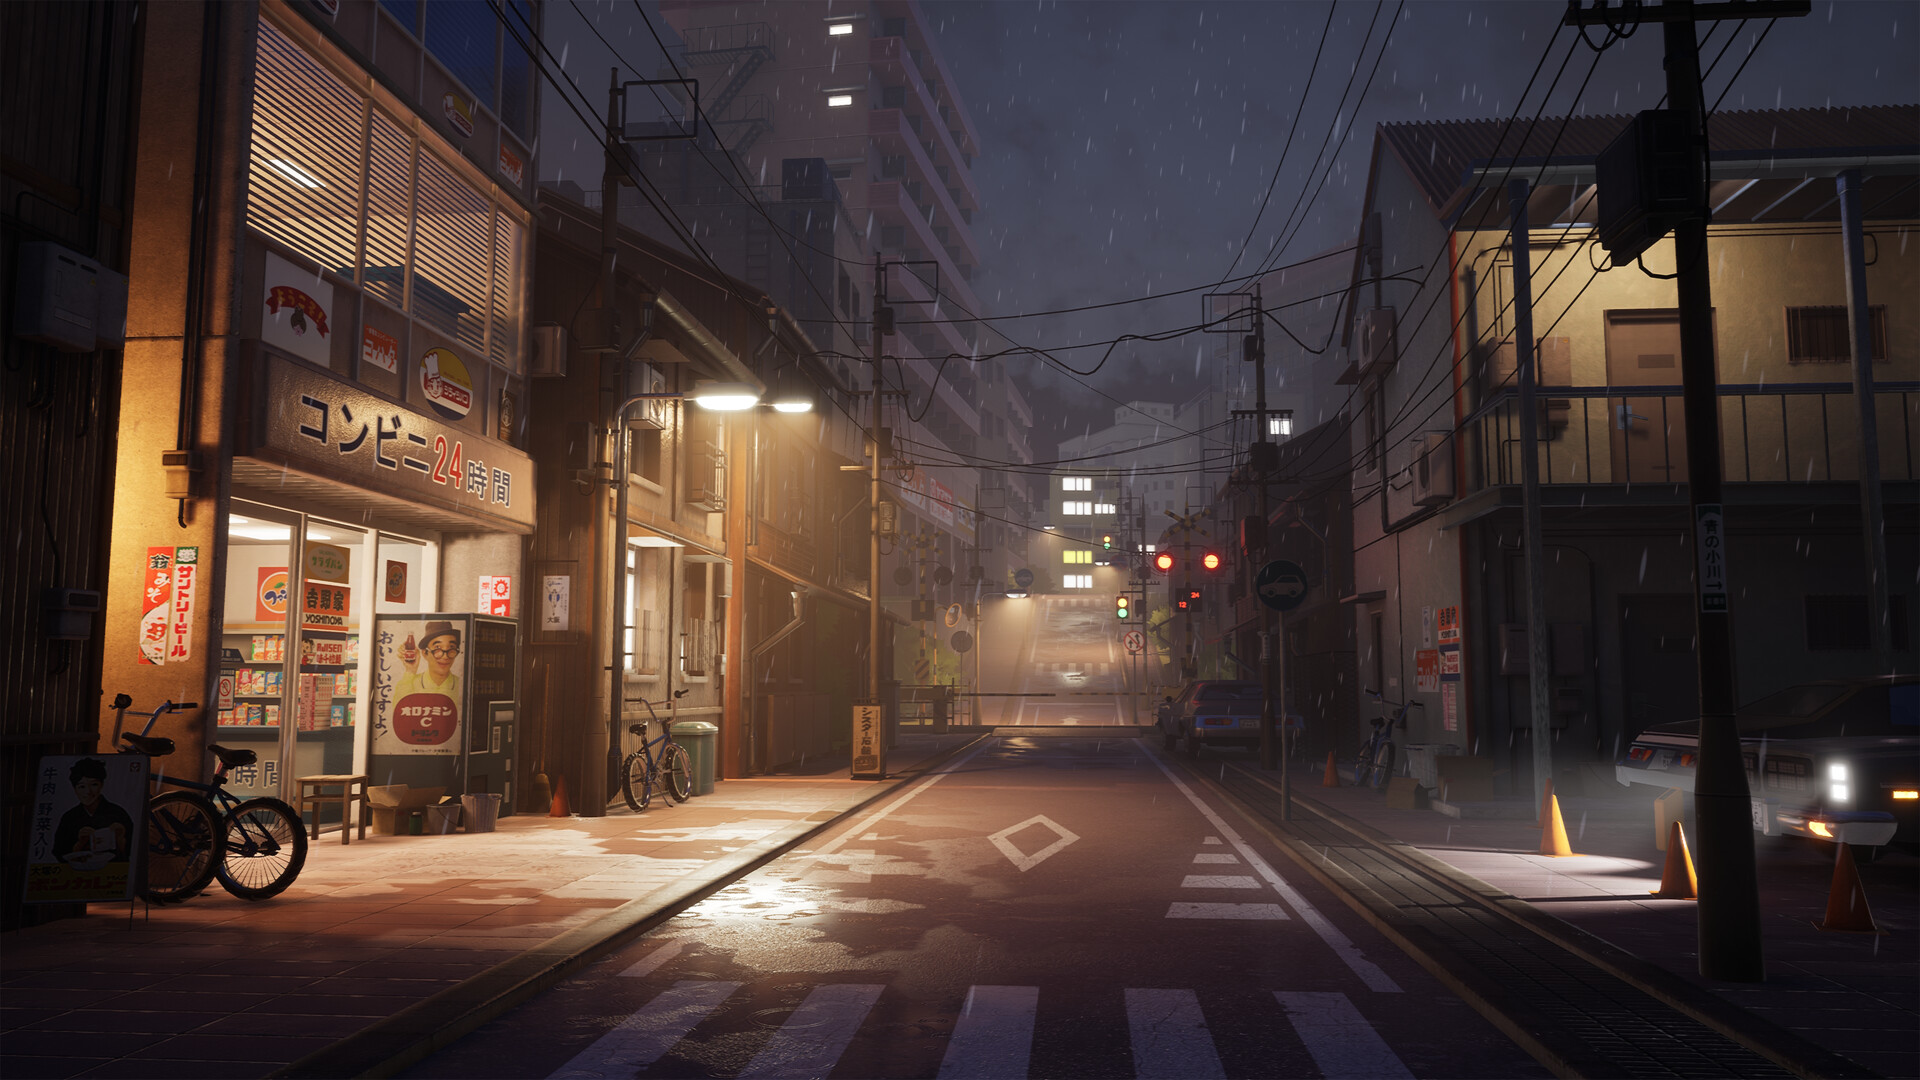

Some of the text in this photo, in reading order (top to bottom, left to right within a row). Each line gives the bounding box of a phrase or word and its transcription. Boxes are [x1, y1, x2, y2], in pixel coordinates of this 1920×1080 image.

[300, 395, 511, 507] コンビニ24時間
[1704, 520, 1721, 579] 青の小川
[171, 565, 193, 657] サントリービール
[305, 614, 343, 625] YOSHINOYA
[400, 706, 452, 717] オロナミン
[420, 717, 432, 727] C
[34, 767, 57, 860] 牛肉 野菜入り
